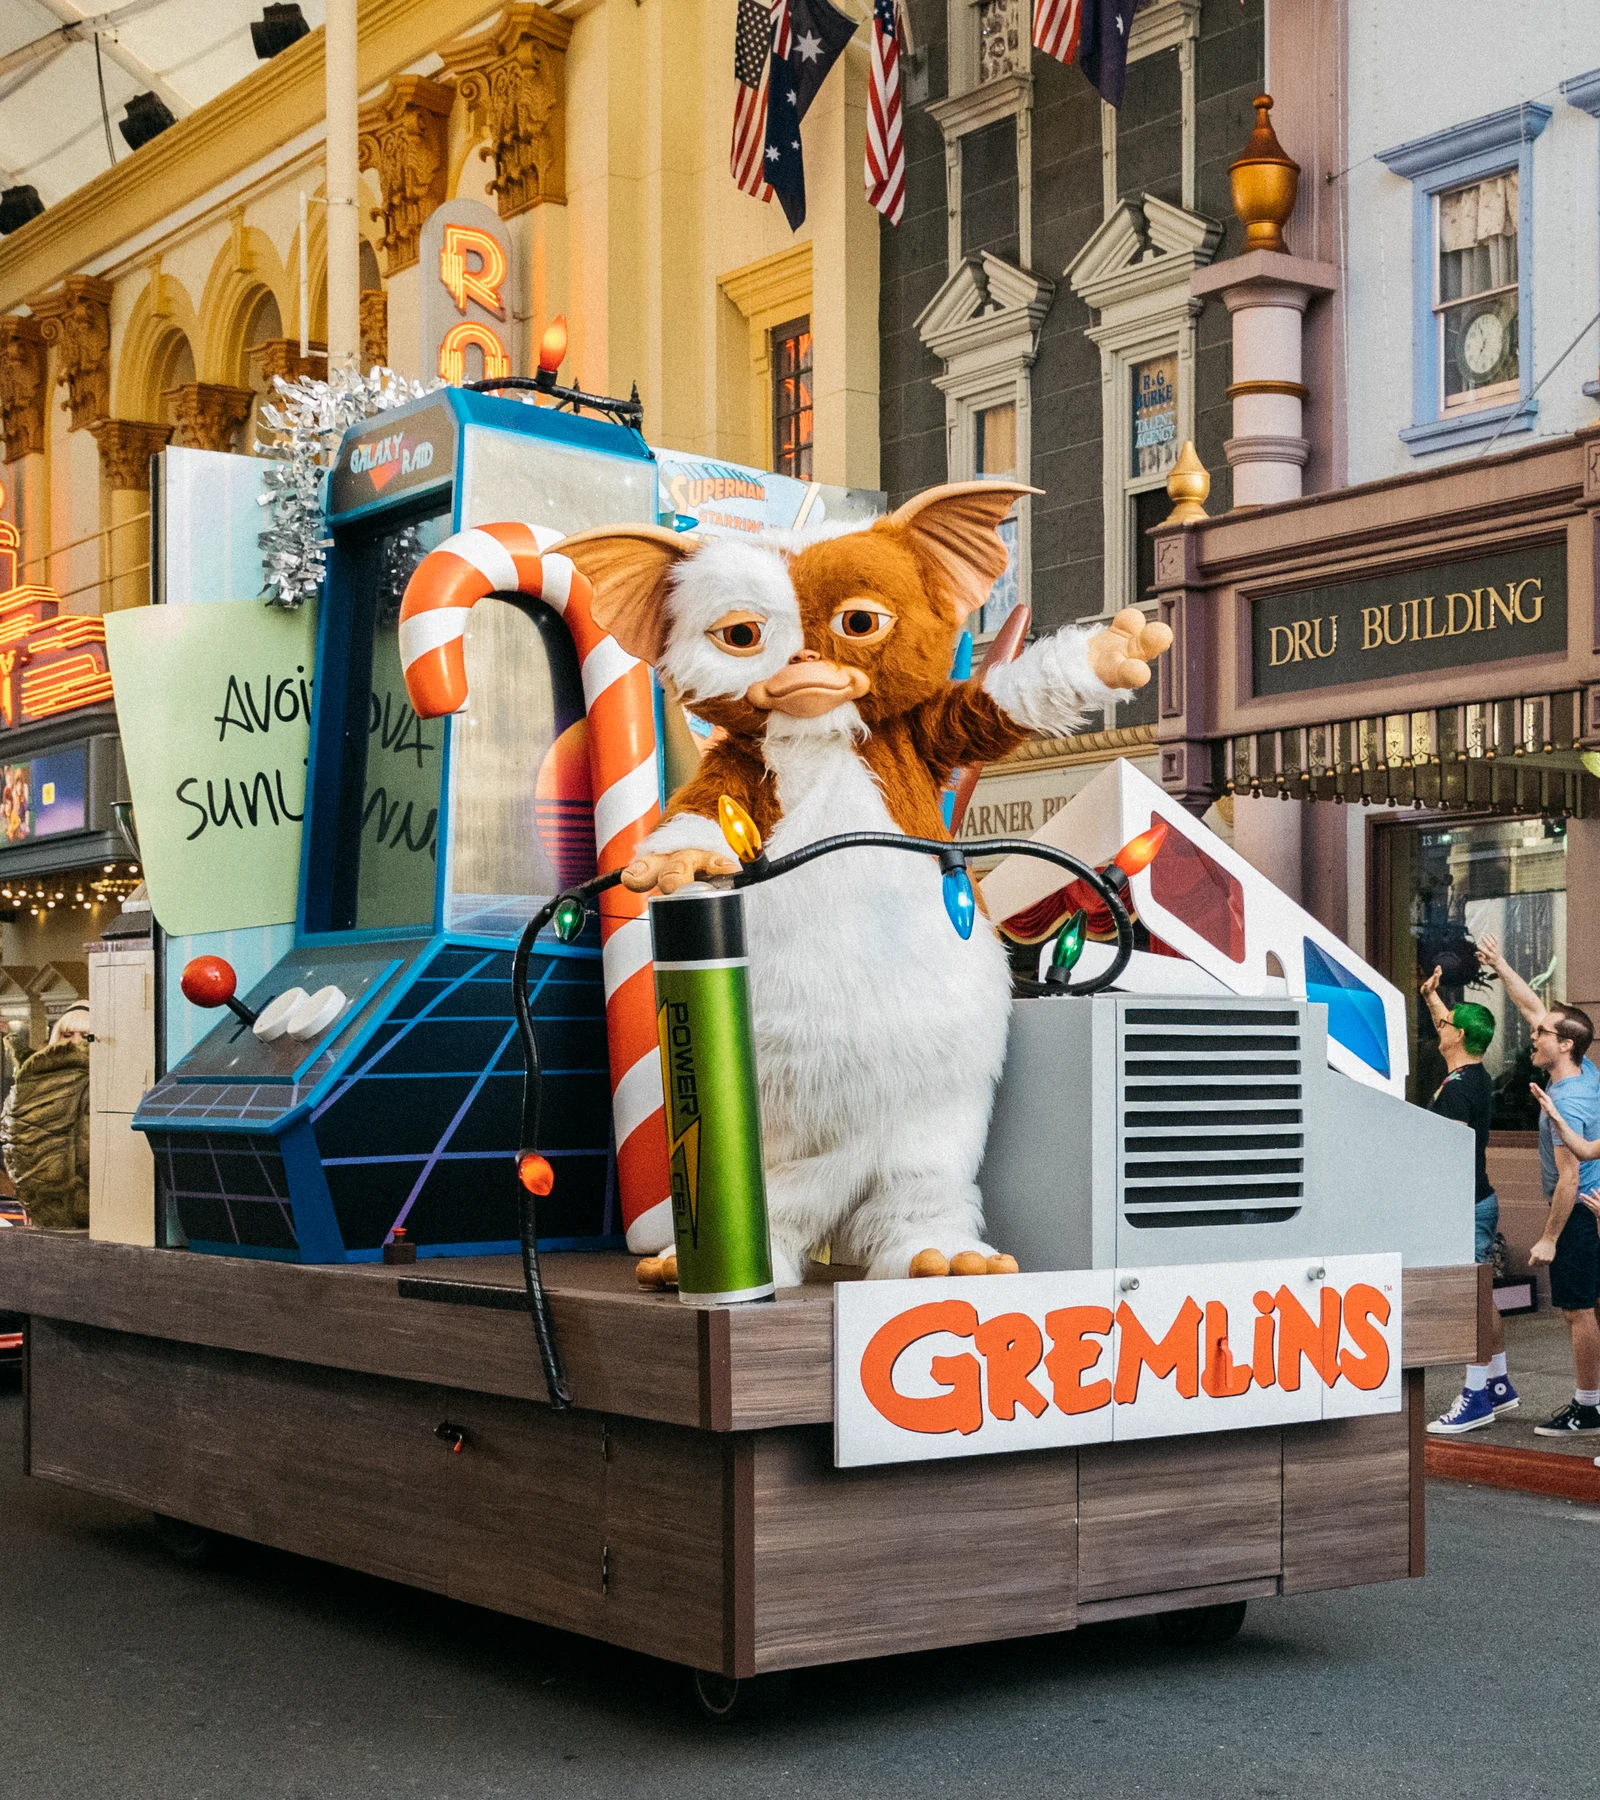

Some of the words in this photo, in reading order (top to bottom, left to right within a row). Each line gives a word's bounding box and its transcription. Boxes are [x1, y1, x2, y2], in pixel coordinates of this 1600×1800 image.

[1135, 384, 1173, 409] BURKE
[1135, 424, 1176, 449] AGENCY
[1136, 410, 1174, 434] TALENT
[350, 432, 403, 473] GALAXY
[401, 441, 434, 475] RAID
[670, 474, 766, 515] SUPERMAN
[1268, 615, 1338, 666] DRU
[1360, 577, 1545, 650] BUILDING
[669, 1002, 700, 1119] POWER
[671, 1171, 689, 1246] CELL
